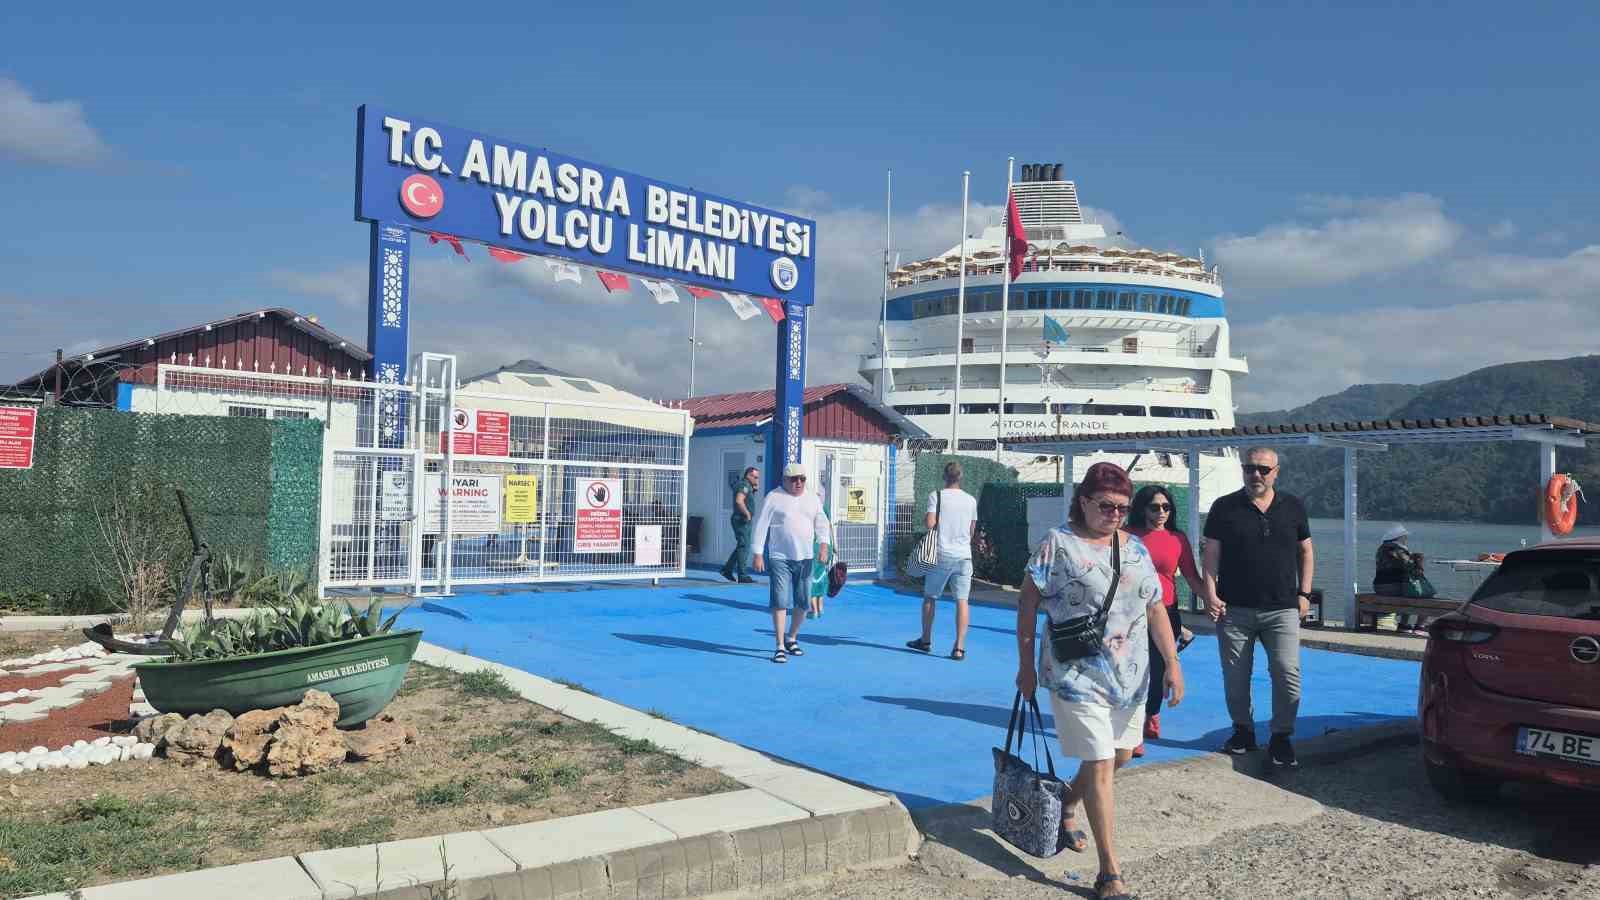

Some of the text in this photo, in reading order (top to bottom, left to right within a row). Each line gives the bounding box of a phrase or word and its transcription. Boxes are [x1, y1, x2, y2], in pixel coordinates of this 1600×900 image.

[383, 116, 454, 175] T.C.
[460, 138, 631, 216] AMASRA
[495, 193, 736, 281] YOLCU LİMANI
[452, 479, 479, 487] YARI
[307, 669, 340, 683] AMASRA
[1529, 731, 1592, 757] 74 BE
